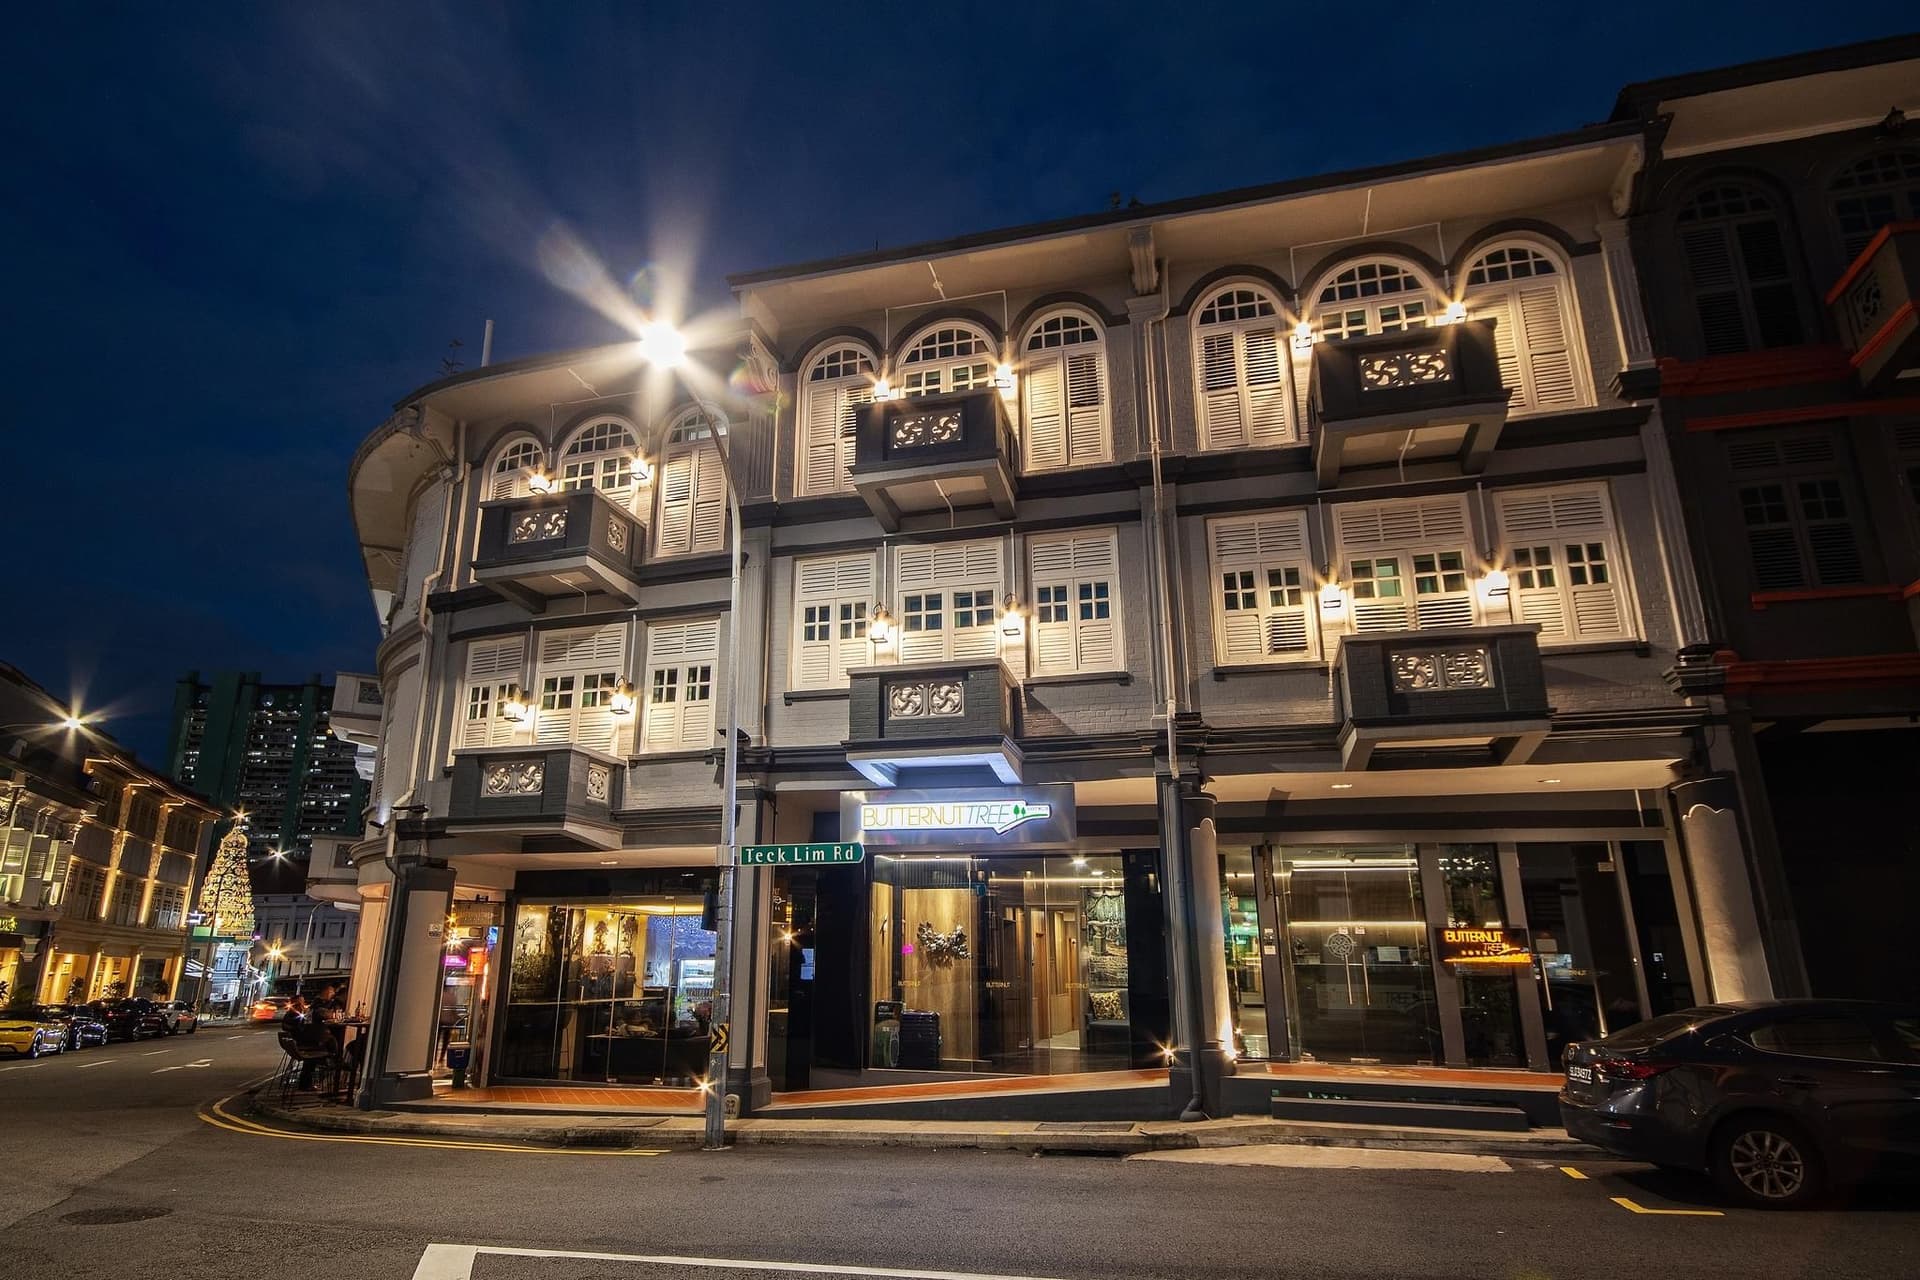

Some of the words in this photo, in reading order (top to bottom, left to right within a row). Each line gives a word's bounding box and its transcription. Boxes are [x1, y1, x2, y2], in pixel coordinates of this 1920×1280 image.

[745, 848, 786, 863] Teck
[794, 847, 825, 862] Lim
[834, 846, 854, 861] Rd
[1444, 930, 1503, 943] BUTTERNUT
[1483, 943, 1502, 952] TREE
